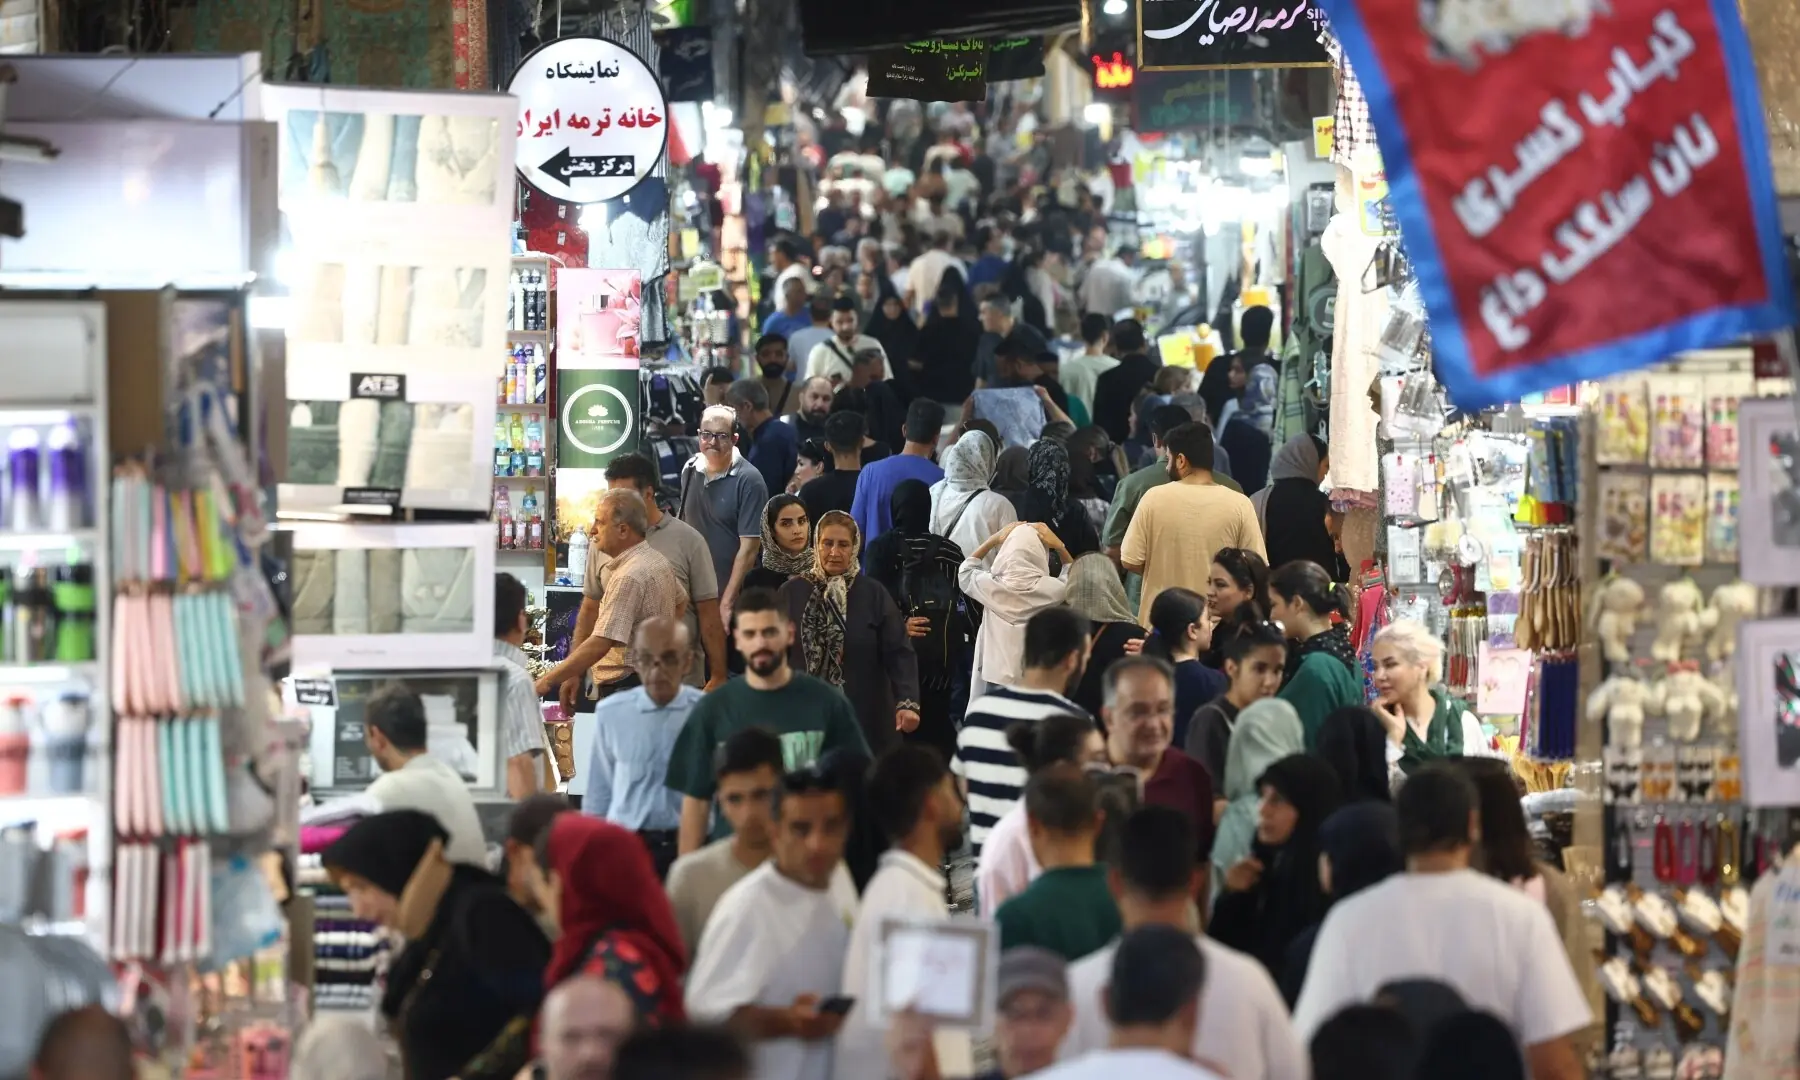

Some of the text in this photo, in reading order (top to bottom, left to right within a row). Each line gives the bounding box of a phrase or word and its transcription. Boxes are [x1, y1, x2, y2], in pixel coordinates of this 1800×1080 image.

[1306, 8, 1329, 20] SIN
[566, 107, 612, 137] ترمه
[617, 106, 662, 129] خانه
[560, 157, 633, 176] مرکز پخش
[1452, 97, 1584, 238] کسری
[1650, 111, 1720, 199] نان
[1478, 267, 1548, 352] داغ
